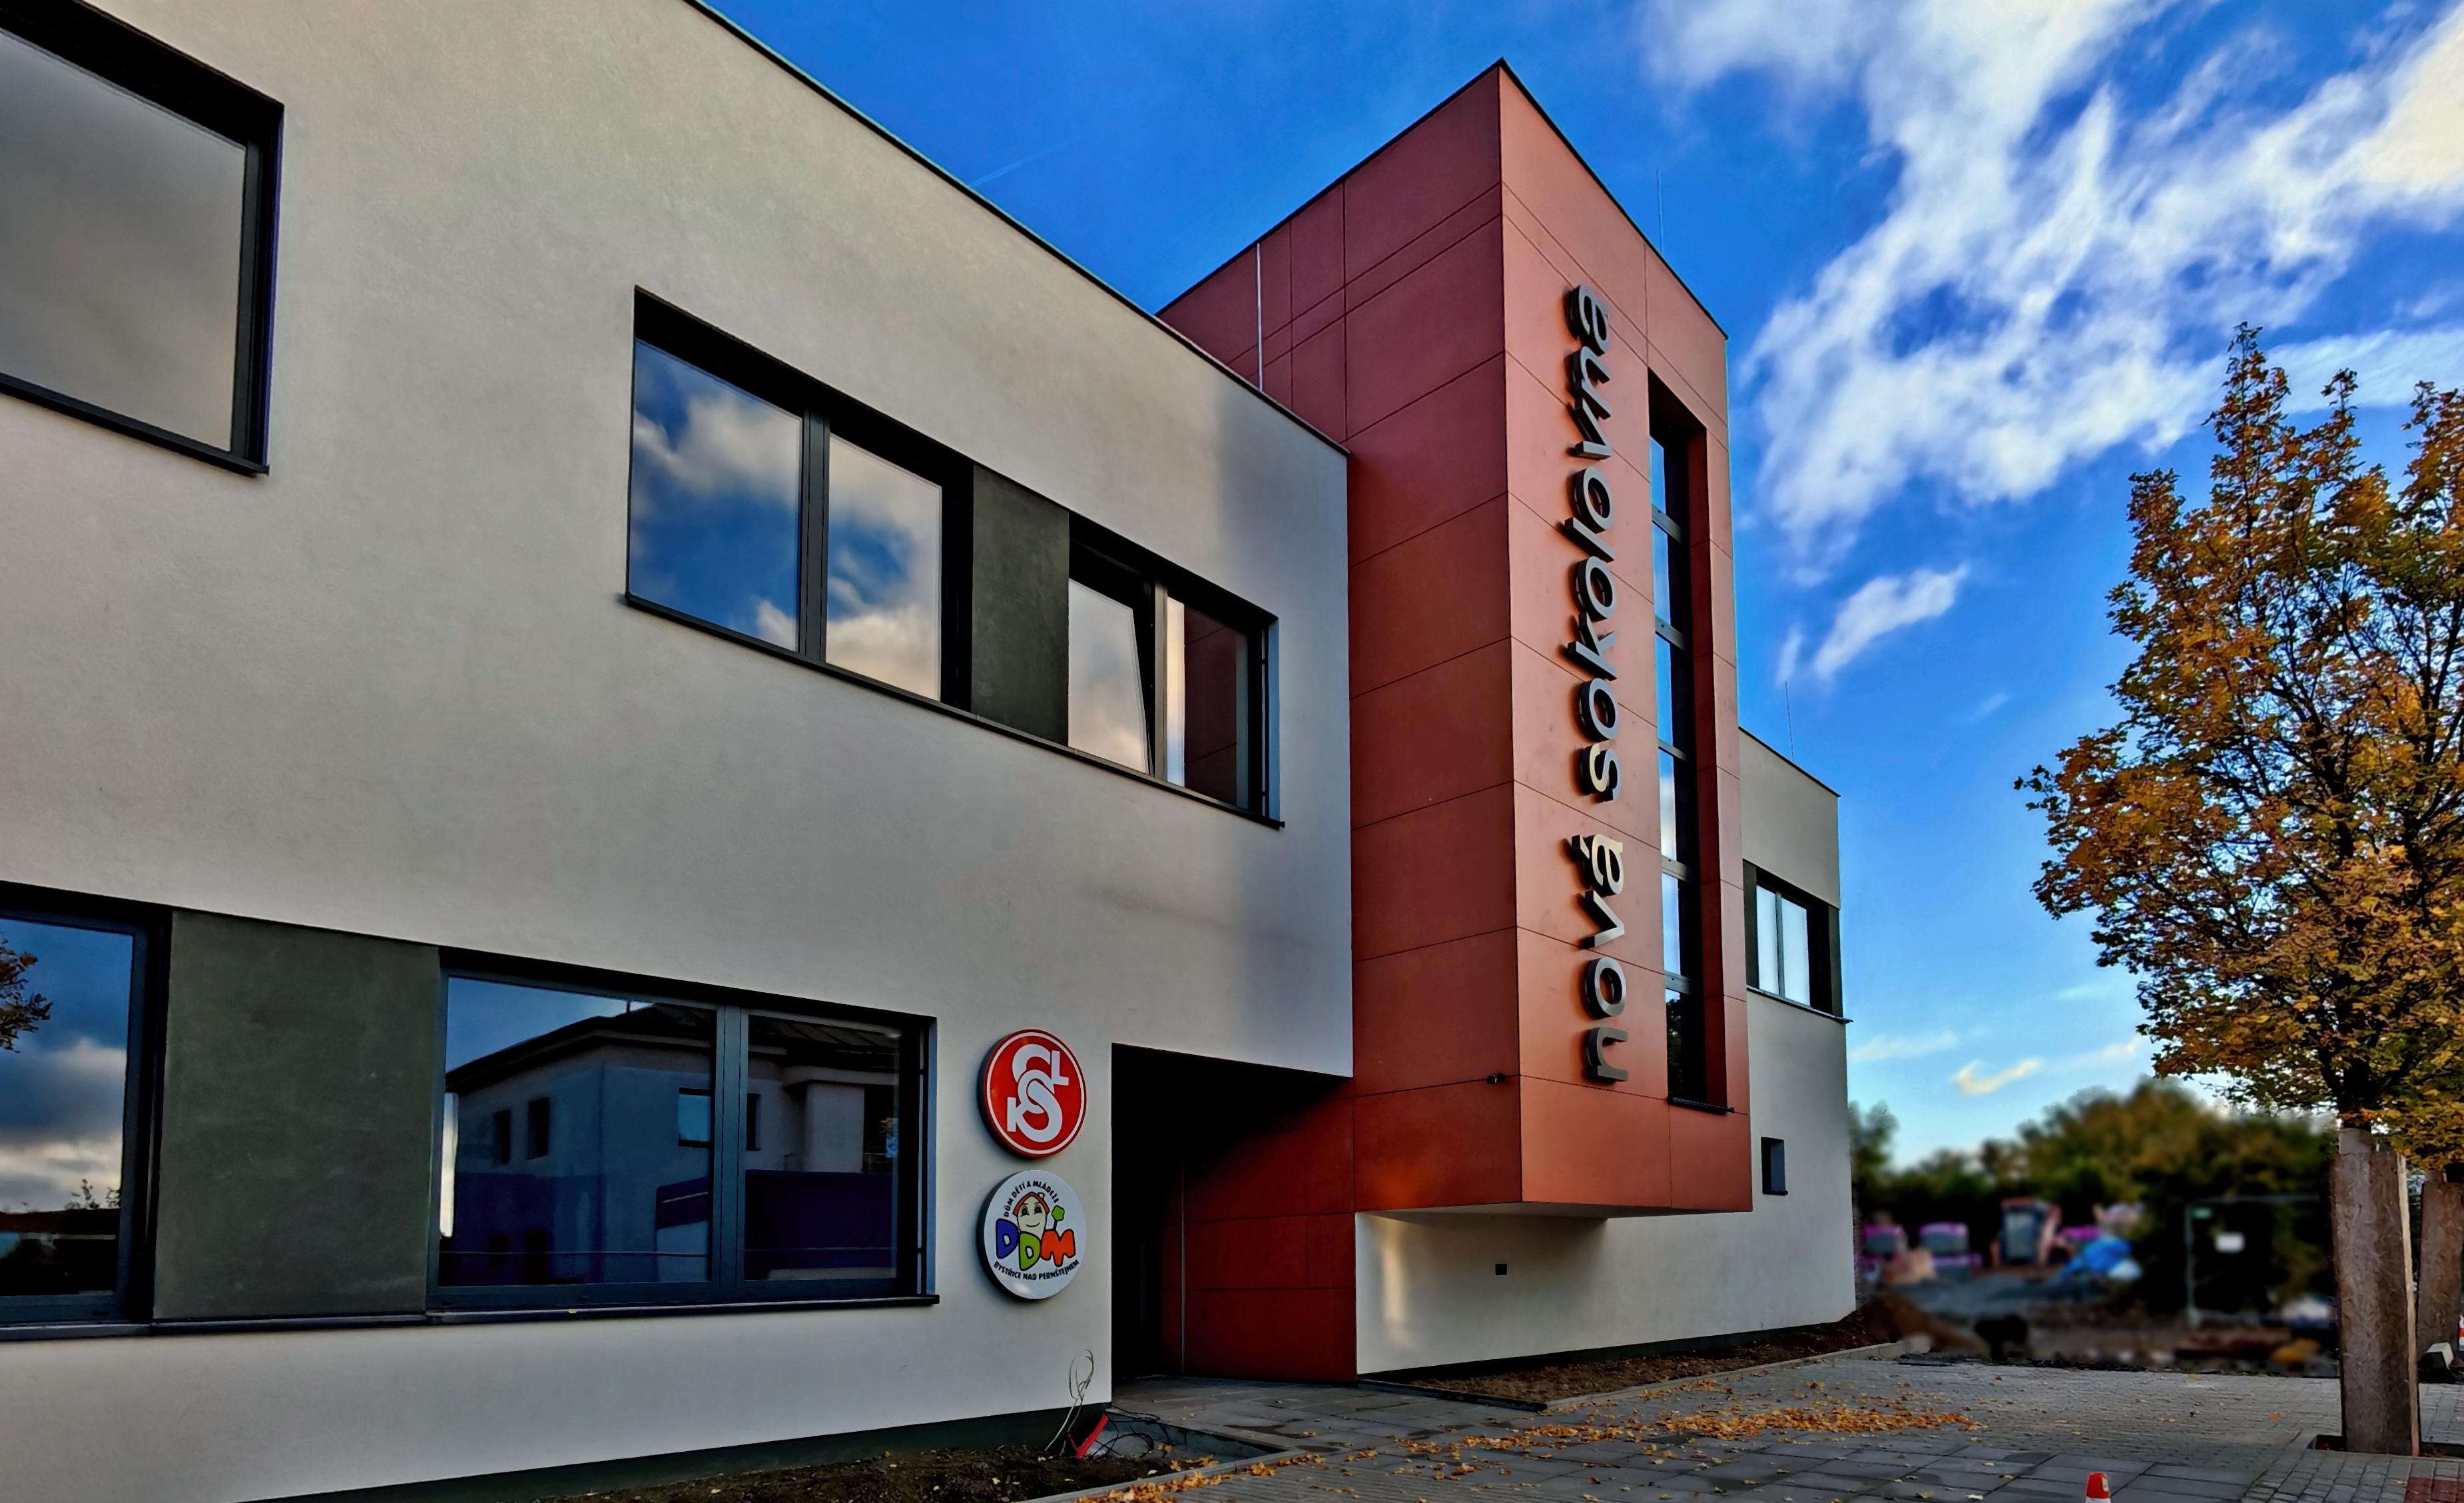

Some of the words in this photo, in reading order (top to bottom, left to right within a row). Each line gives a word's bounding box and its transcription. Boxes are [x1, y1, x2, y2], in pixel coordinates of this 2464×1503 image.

[1564, 284, 1622, 801] sokolovna
[1572, 834, 1628, 1082] nová
[996, 1218, 1076, 1271] DDM
[1004, 1197, 1014, 1217] DŮM
